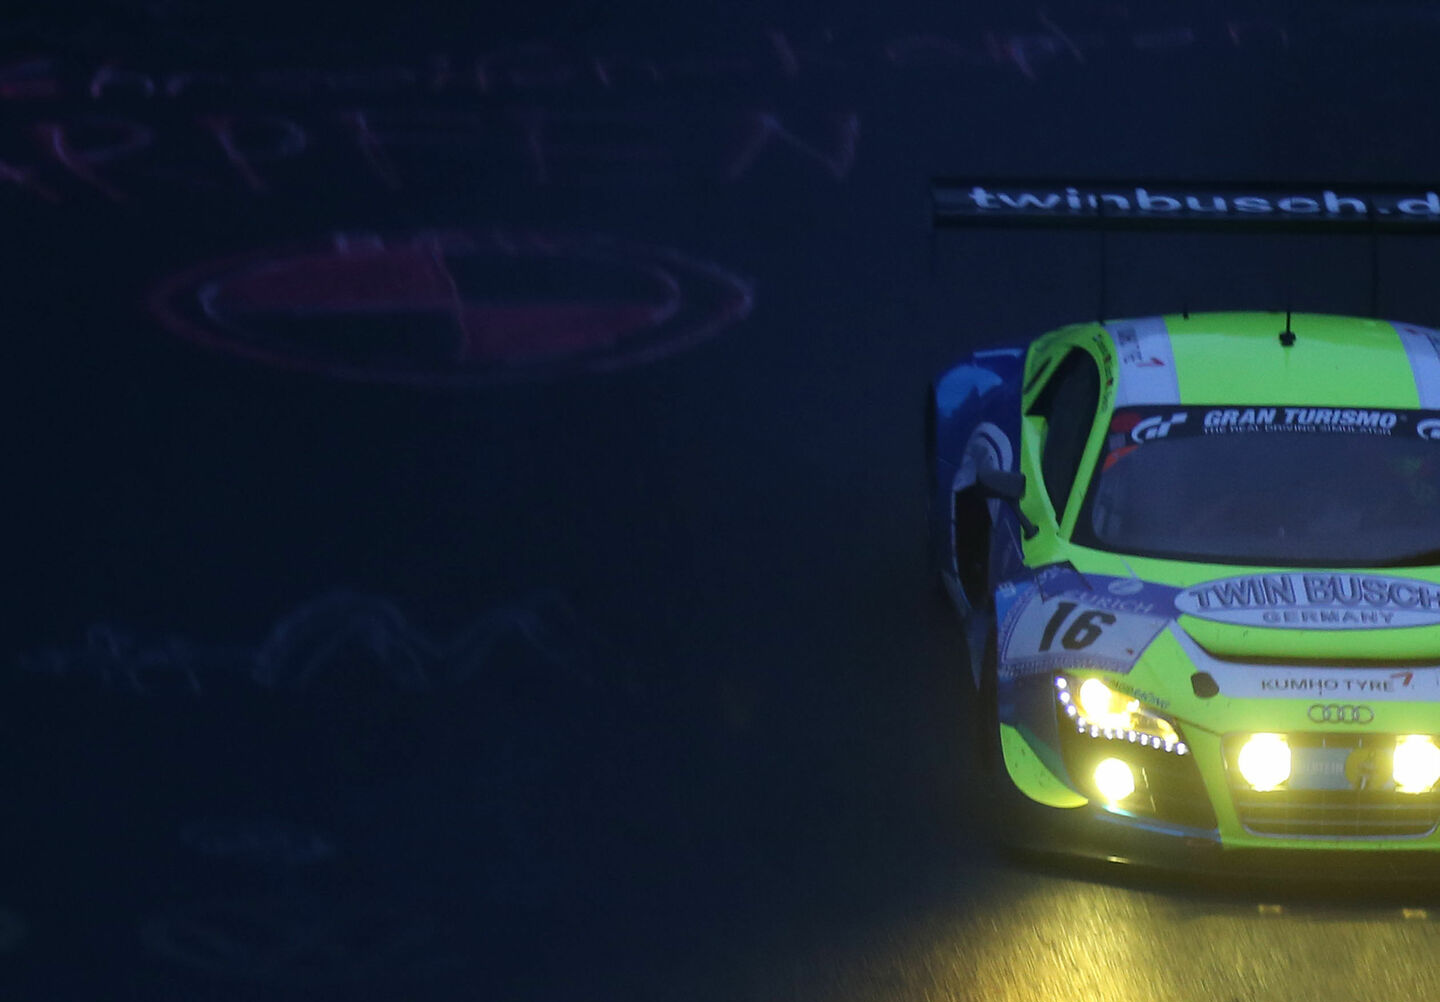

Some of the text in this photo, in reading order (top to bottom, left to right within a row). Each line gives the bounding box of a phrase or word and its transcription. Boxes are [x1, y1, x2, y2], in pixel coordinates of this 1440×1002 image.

[1203, 408, 1398, 429] GRAN TURISMO
[1189, 574, 1297, 609] TWIN
[1039, 602, 1117, 652] 16
[1263, 611, 1395, 624] GERMANY
[1261, 678, 1394, 692] KUMHO TYRE
